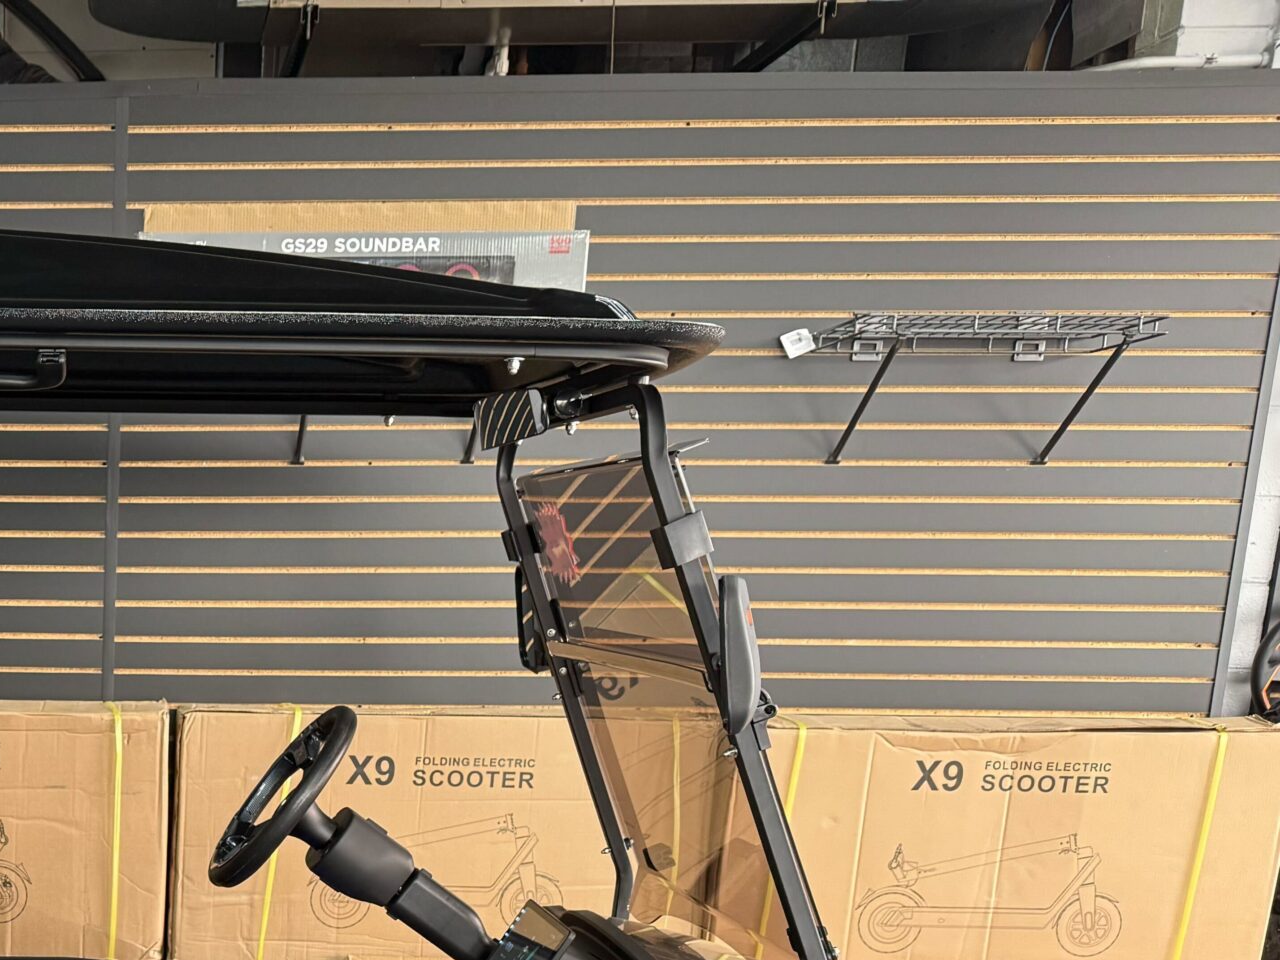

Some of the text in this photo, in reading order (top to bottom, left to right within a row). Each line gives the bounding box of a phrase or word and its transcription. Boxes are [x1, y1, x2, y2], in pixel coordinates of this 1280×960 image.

[281, 237, 441, 253] GS29 SOUNDBAR
[346, 755, 396, 786] X9
[415, 756, 536, 768] FOLDING ELECTRIC
[984, 760, 1112, 772] FOLDING ELECTRIC
[412, 769, 535, 789] SCOOTER
[911, 760, 964, 792] X9
[981, 774, 1110, 794] SCOOTER
